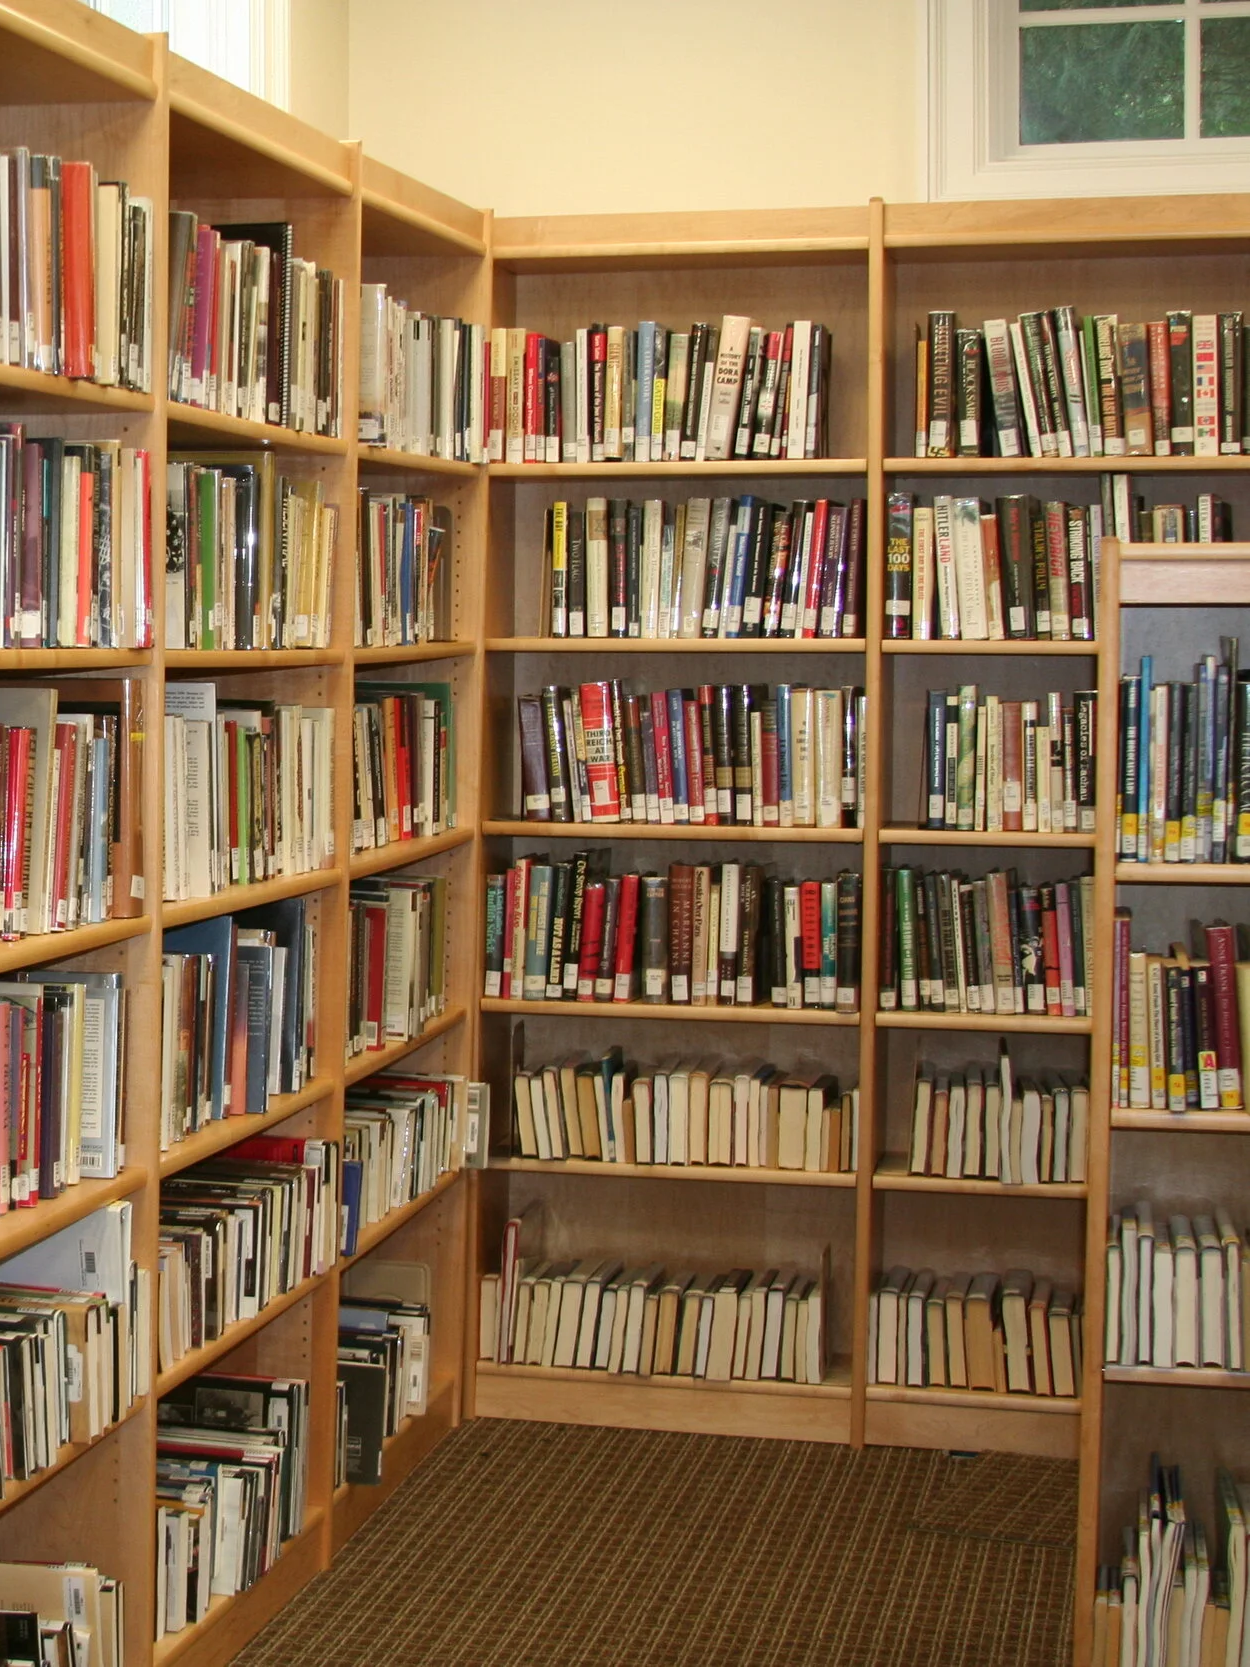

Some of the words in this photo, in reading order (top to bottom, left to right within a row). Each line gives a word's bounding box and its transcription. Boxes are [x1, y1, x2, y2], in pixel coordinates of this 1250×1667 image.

[934, 324, 950, 384] HUNTING
[990, 336, 1009, 392] BLOODLANDS
[717, 377, 739, 385] CAMP
[966, 360, 977, 392] BLACK
[933, 388, 948, 416] EVIL
[937, 505, 952, 563] HITLERLAND
[1048, 512, 1064, 577] HEYDRICH
[1068, 520, 1084, 558] STRIKING
[888, 552, 910, 563] 100
[1070, 560, 1085, 583] BACK
[586, 738, 612, 747] REICH
[1078, 700, 1088, 748] Legacies
[1079, 751, 1088, 760] of
[672, 920, 680, 967] CHAINS
[681, 901, 690, 966] MARIANNE
